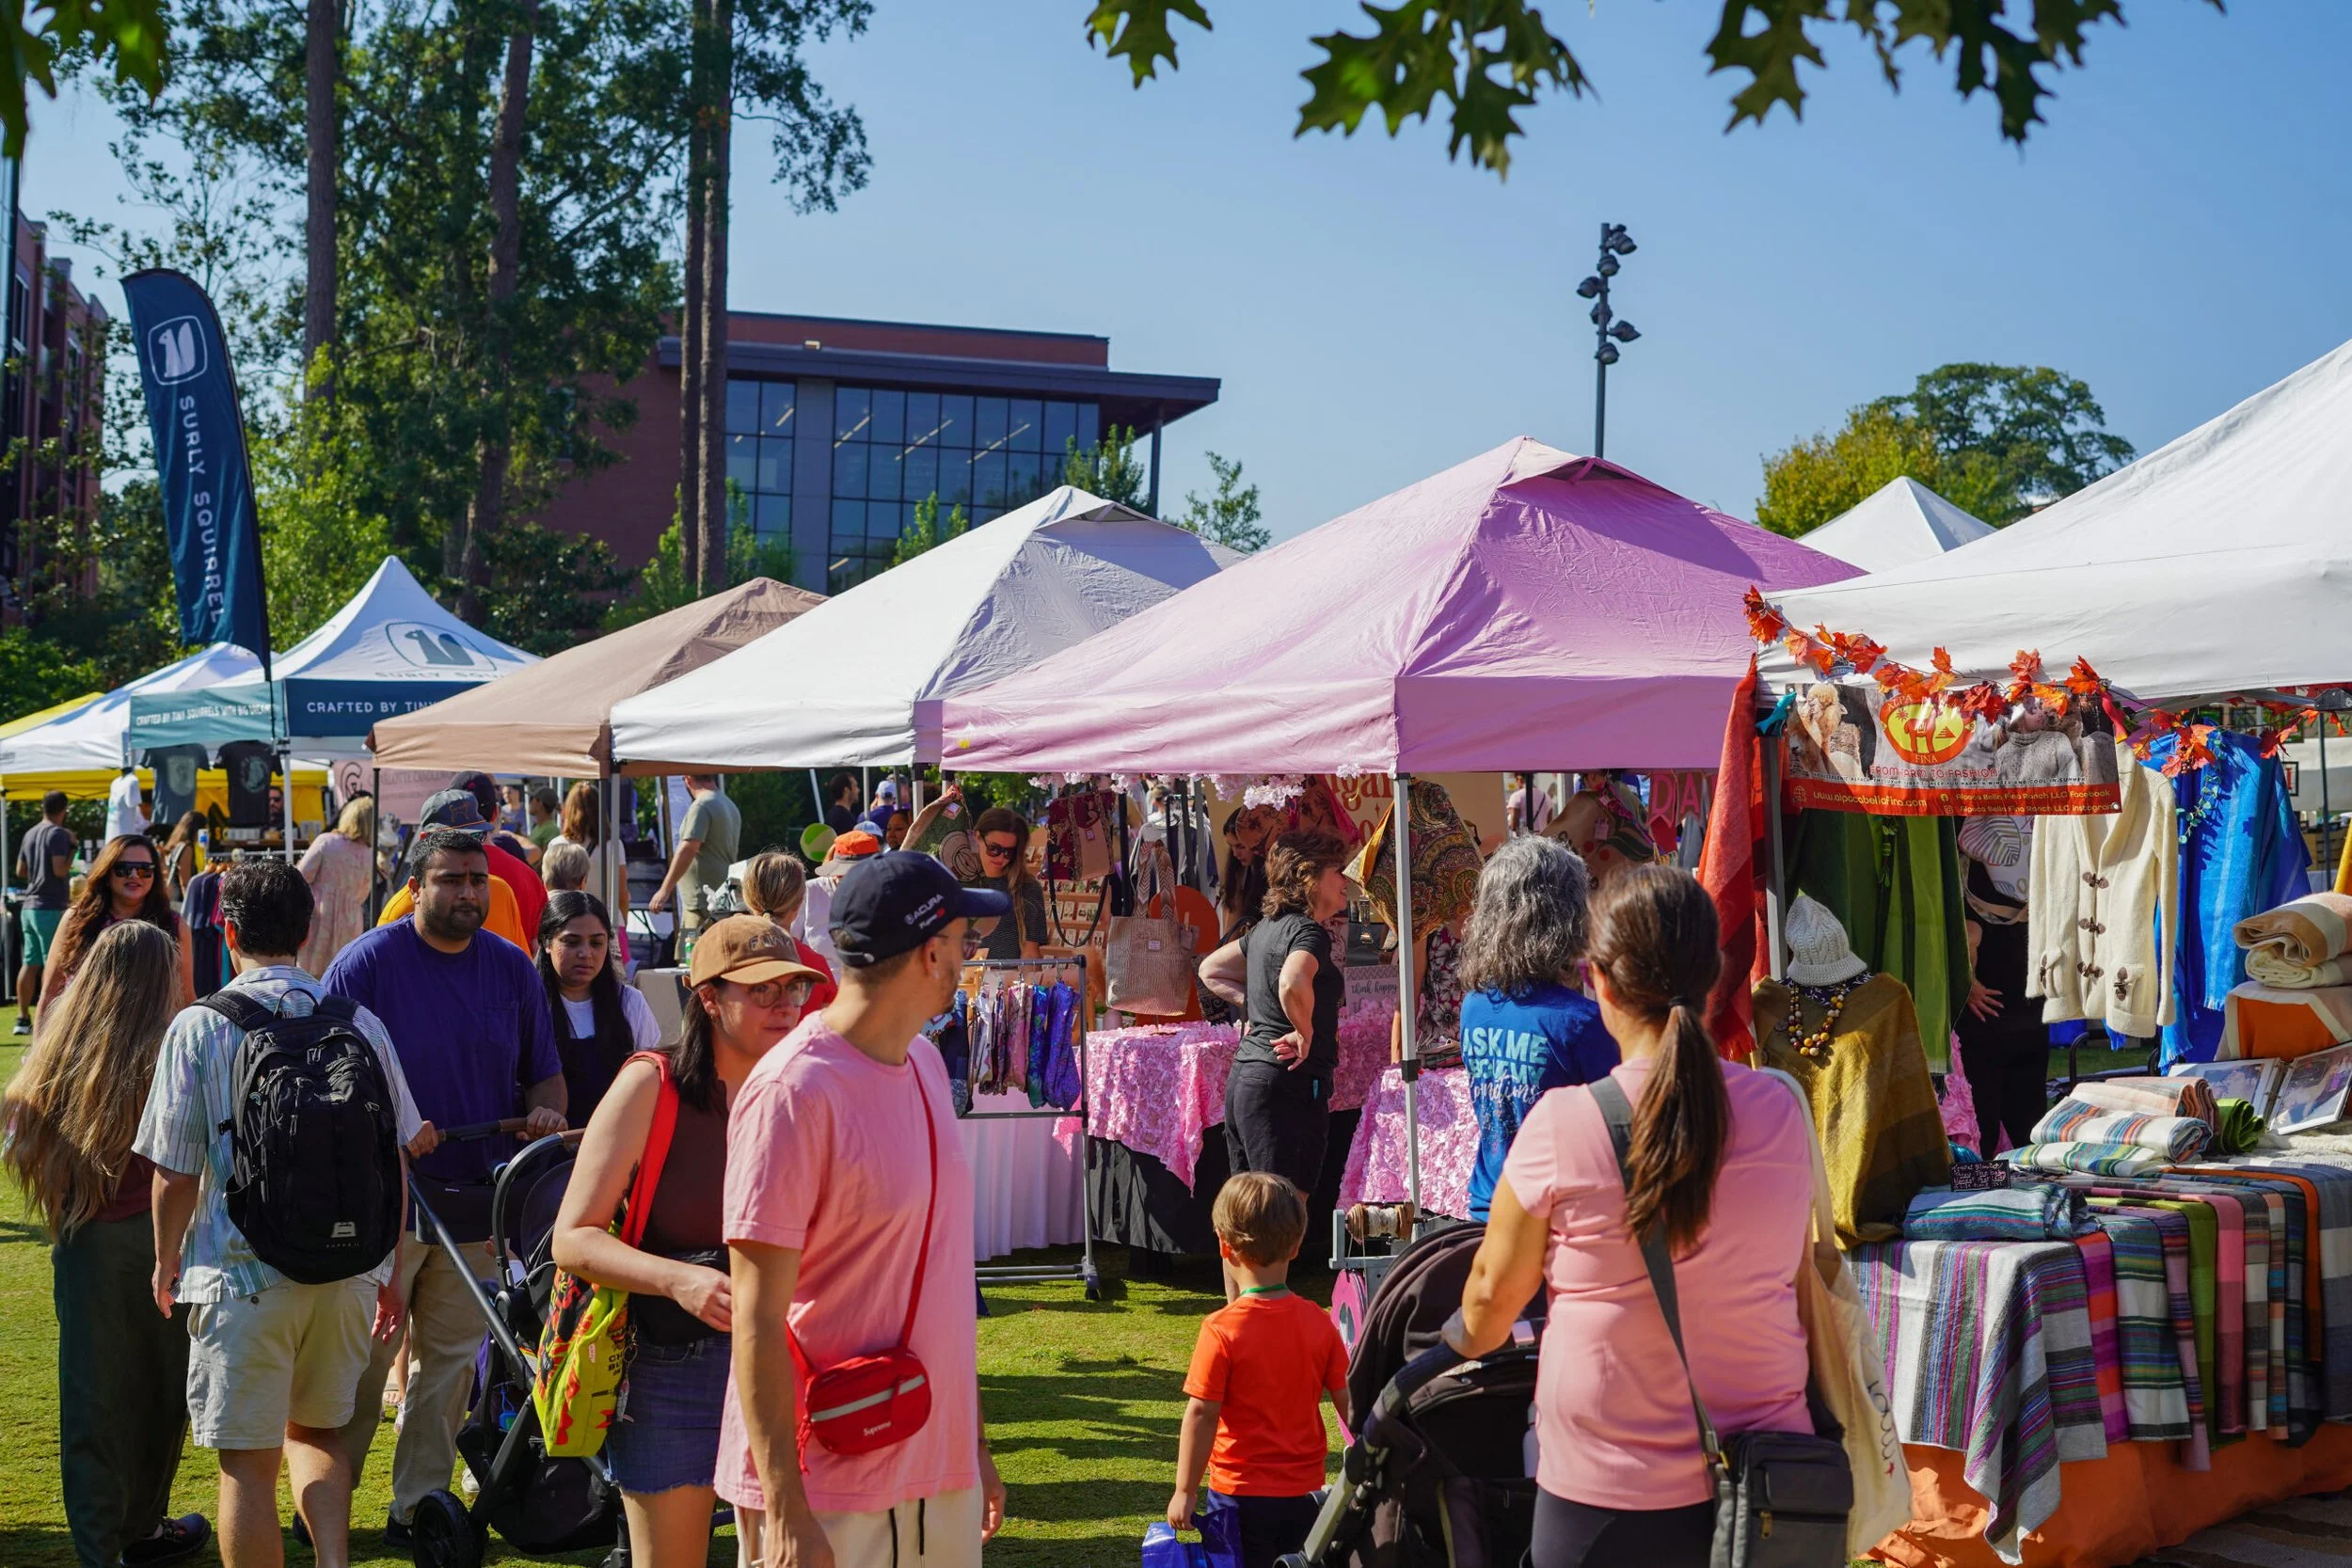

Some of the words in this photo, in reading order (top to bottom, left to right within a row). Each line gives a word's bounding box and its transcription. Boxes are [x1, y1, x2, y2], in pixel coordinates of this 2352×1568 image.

[179, 395, 205, 475] SURLY
[194, 491, 225, 623] SQUIRREL
[135, 713, 161, 726] CRAFTED
[162, 712, 170, 723] BY
[172, 710, 185, 722] TINY
[187, 705, 219, 719] SQUIRRELS
[307, 702, 373, 713] CRAFTED
[380, 702, 396, 713] BY
[1869, 765, 1899, 776] FROM
[1931, 768, 1945, 779] TO
[1948, 768, 1999, 779] FASHION
[1813, 791, 1928, 808] www.alpacabellafina.com
[2050, 791, 2068, 800] LLC
[2069, 790, 2111, 799] Facebook
[914, 894, 945, 920] ACURA
[1351, 981, 1372, 994] think
[1375, 981, 1399, 994] happy
[1463, 1027, 1503, 1057] ASK
[1505, 1030, 1549, 1065] ME
